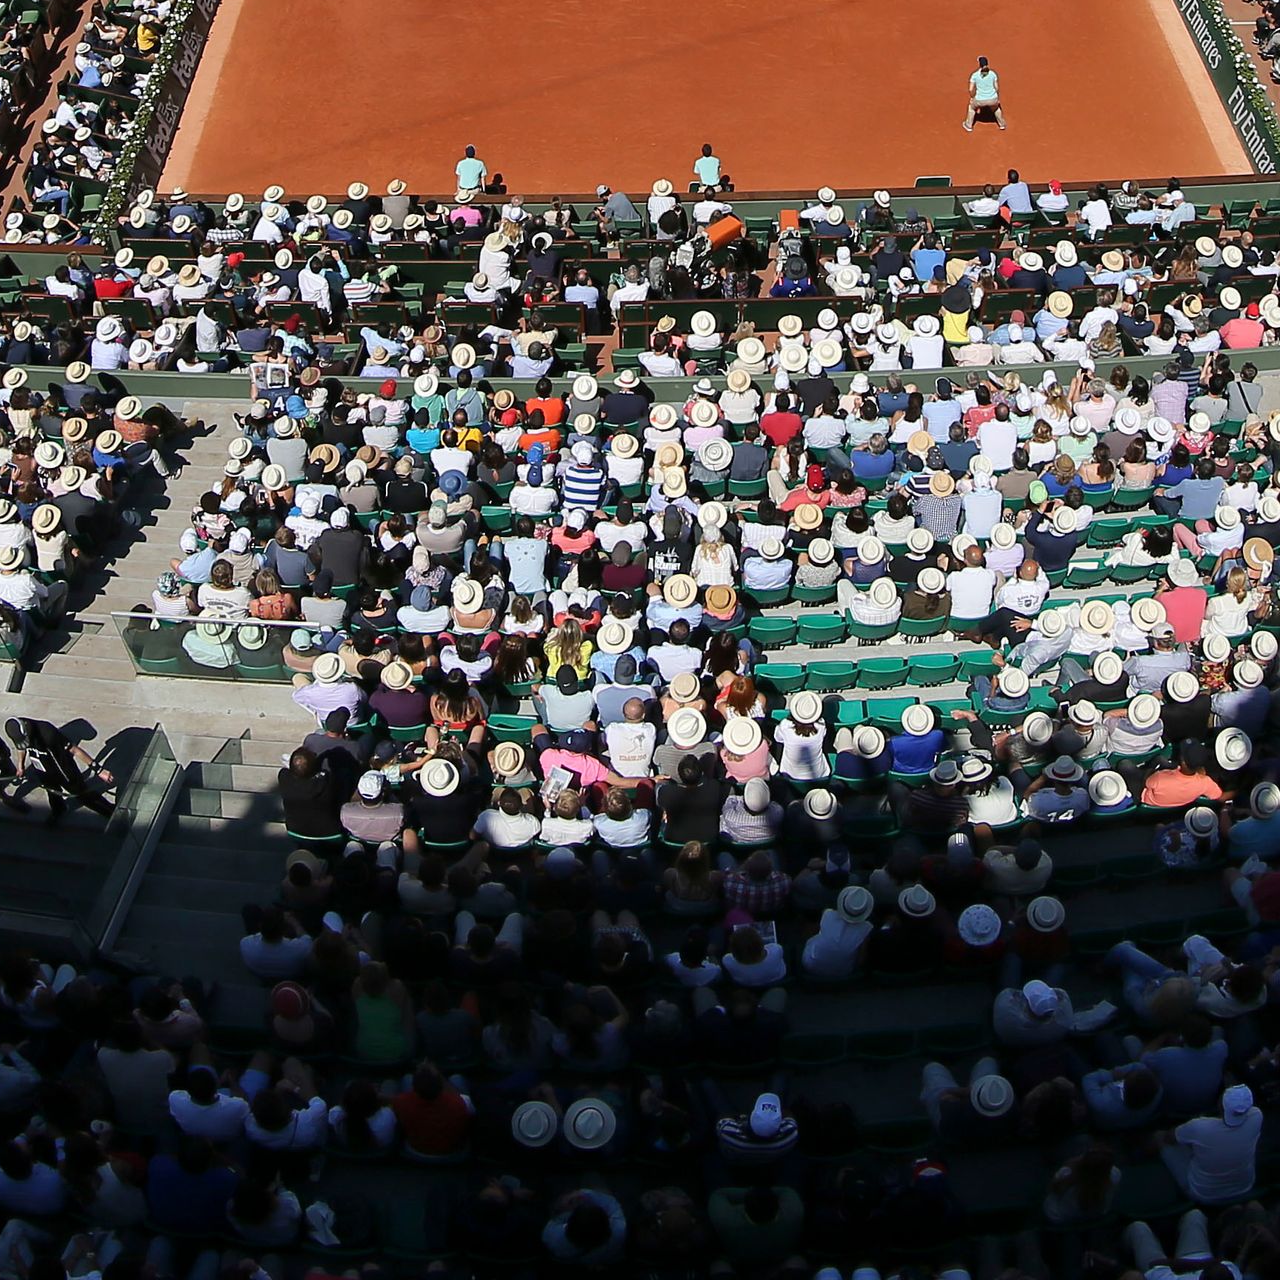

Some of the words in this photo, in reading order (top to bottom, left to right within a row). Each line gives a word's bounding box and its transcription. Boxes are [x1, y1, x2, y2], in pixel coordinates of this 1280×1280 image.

[173, 25, 203, 89] FedEx
[1185, 2, 1221, 70] Emirates
[147, 94, 180, 166] FedEx
[1228, 85, 1246, 127] Fly
[1240, 113, 1277, 174] Emirat
